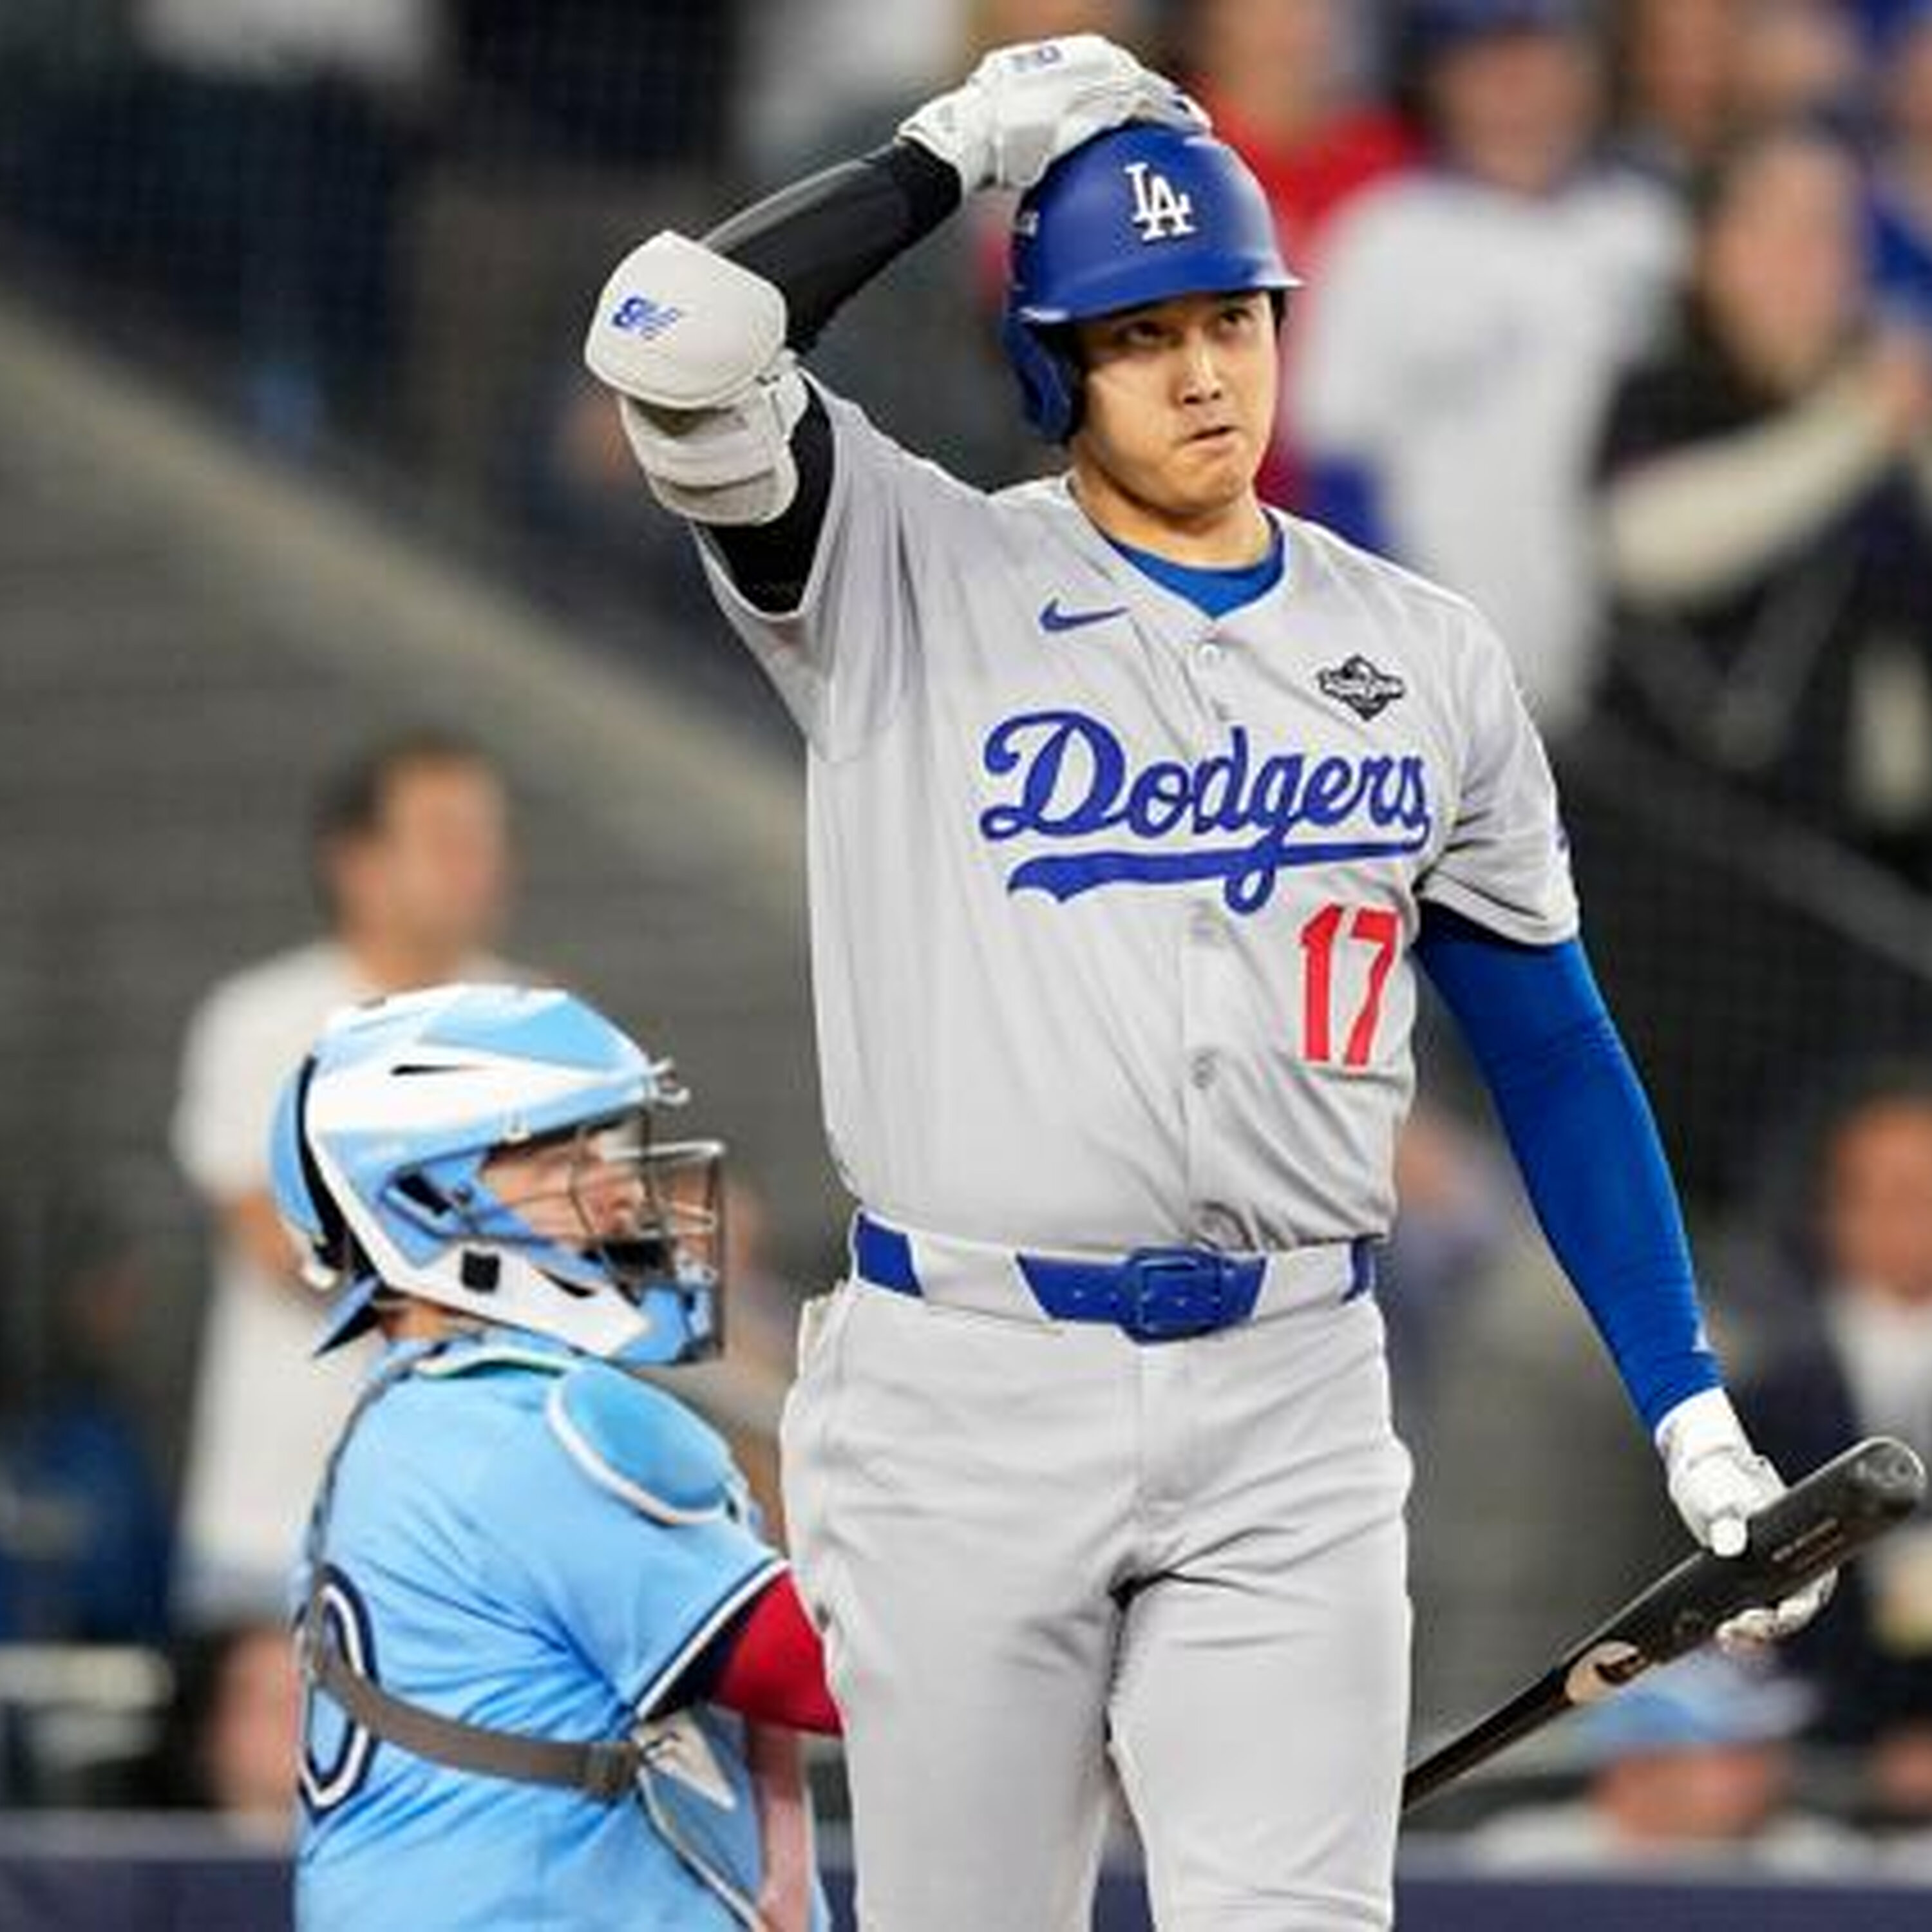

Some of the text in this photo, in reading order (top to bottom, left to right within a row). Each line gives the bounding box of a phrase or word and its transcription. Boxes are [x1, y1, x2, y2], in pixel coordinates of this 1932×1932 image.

[1124, 162, 1195, 242] LA
[979, 710, 1431, 914] Dodgers
[1300, 904, 1399, 1068] 17
